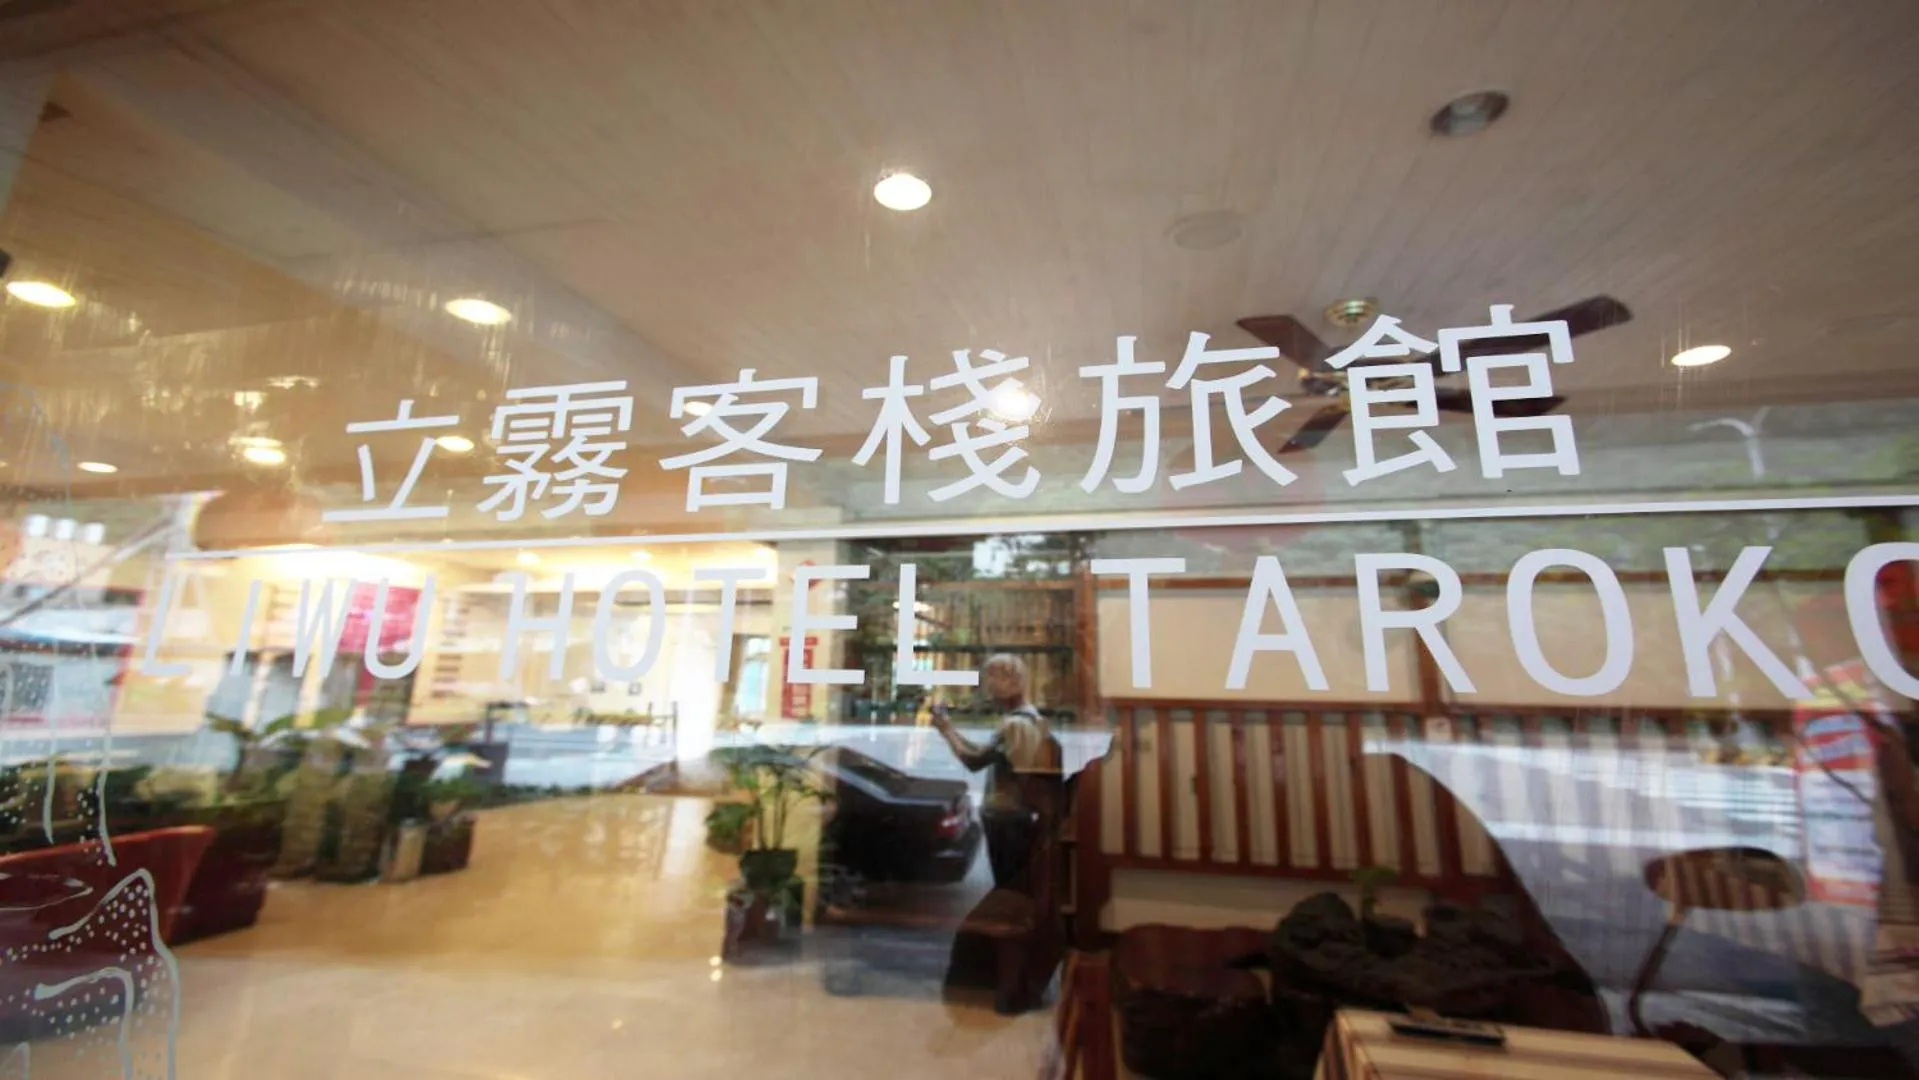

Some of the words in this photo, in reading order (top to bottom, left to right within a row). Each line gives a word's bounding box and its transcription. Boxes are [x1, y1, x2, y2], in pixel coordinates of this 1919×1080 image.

[322, 304, 1581, 522] 立霧客棧旅館
[140, 573, 435, 679] LIWU
[499, 563, 979, 686] HOTEL
